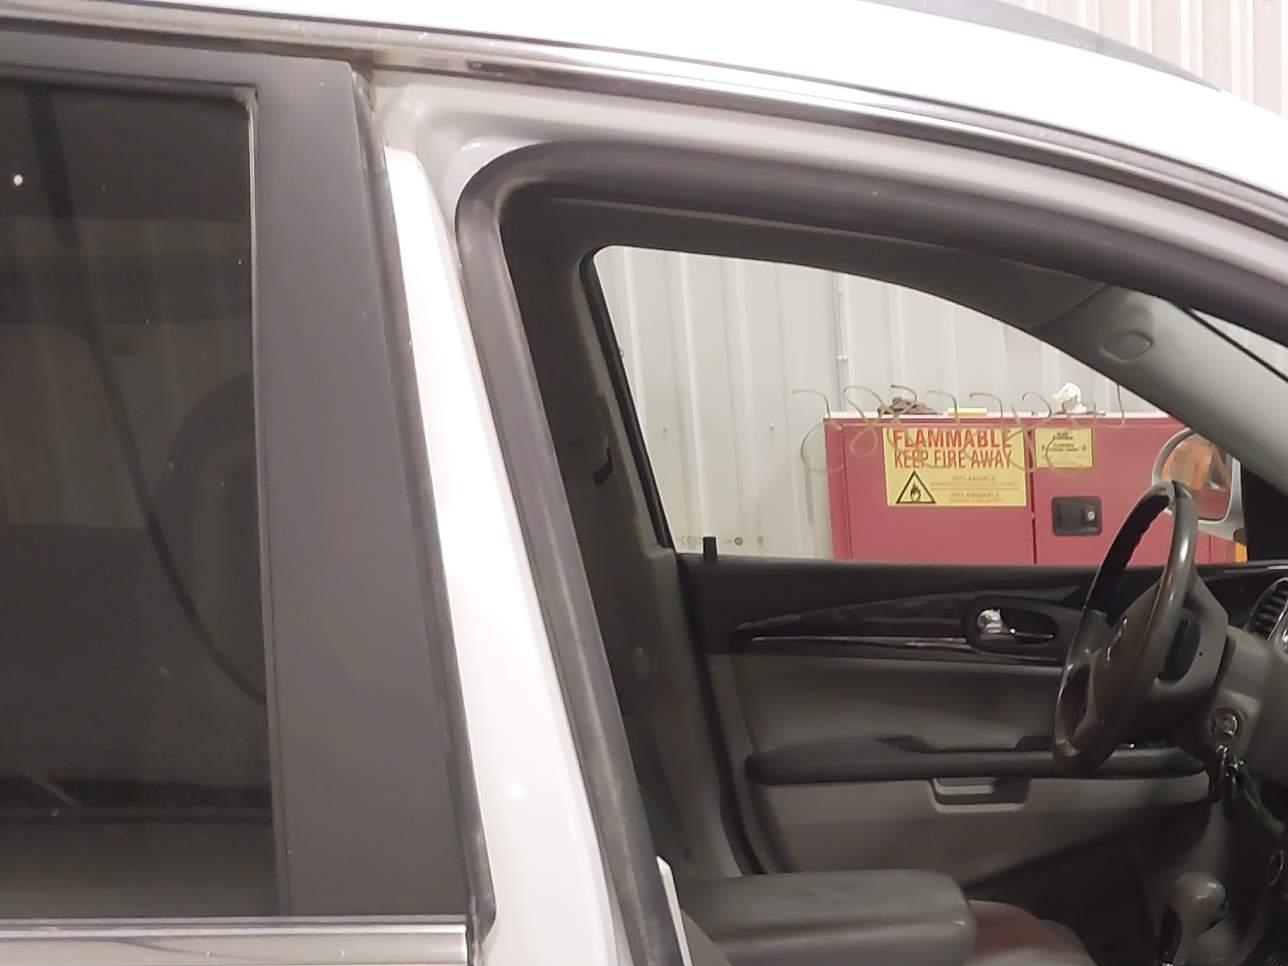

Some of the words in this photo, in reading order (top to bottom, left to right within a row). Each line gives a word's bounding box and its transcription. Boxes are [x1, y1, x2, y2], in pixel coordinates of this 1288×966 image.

[893, 429, 1012, 448] FLAMMABLE
[895, 450, 929, 469] KEEP
[934, 450, 966, 469] FIRE
[971, 450, 1012, 469] AWAY
